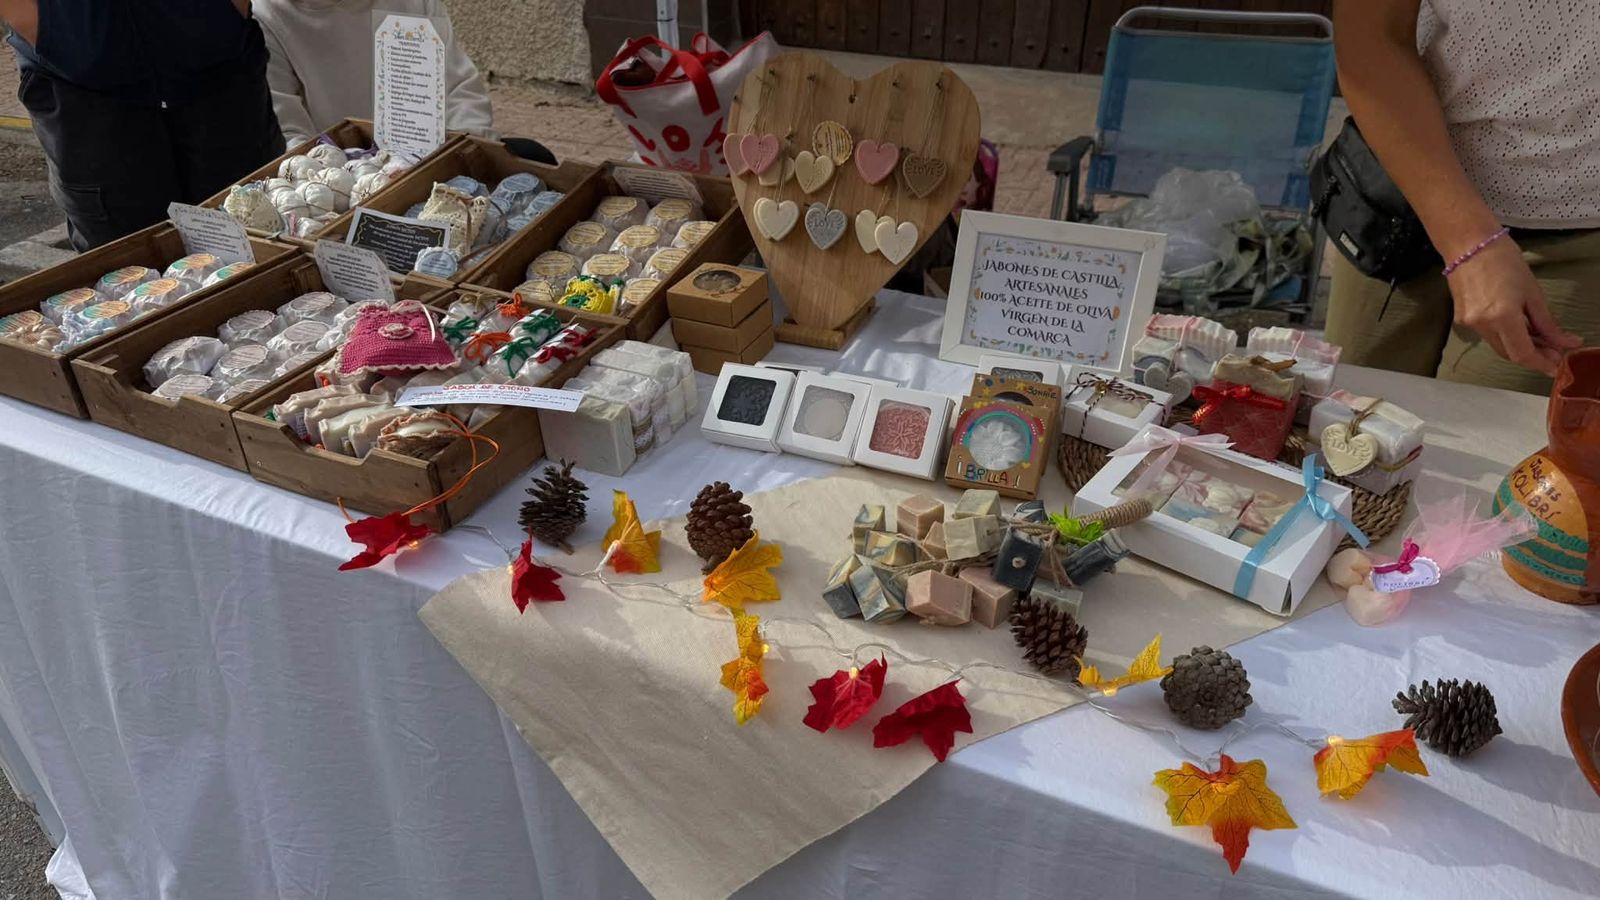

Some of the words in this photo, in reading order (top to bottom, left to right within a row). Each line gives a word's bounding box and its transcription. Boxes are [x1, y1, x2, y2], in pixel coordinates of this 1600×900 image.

[983, 259, 1039, 277] JABONES
[1041, 267, 1059, 278] DE
[1061, 269, 1120, 289] CASTILLA
[1004, 278, 1088, 300] ARTESANALES
[981, 291, 1007, 303] 100%
[1009, 295, 1052, 310] ACEITE
[1056, 301, 1074, 312] DE
[1076, 303, 1114, 321] OLIVA
[1001, 309, 1050, 326] VIRGEN
[1051, 315, 1069, 328] DE
[1070, 319, 1085, 333] LA
[1007, 325, 1071, 346] COMARCA
